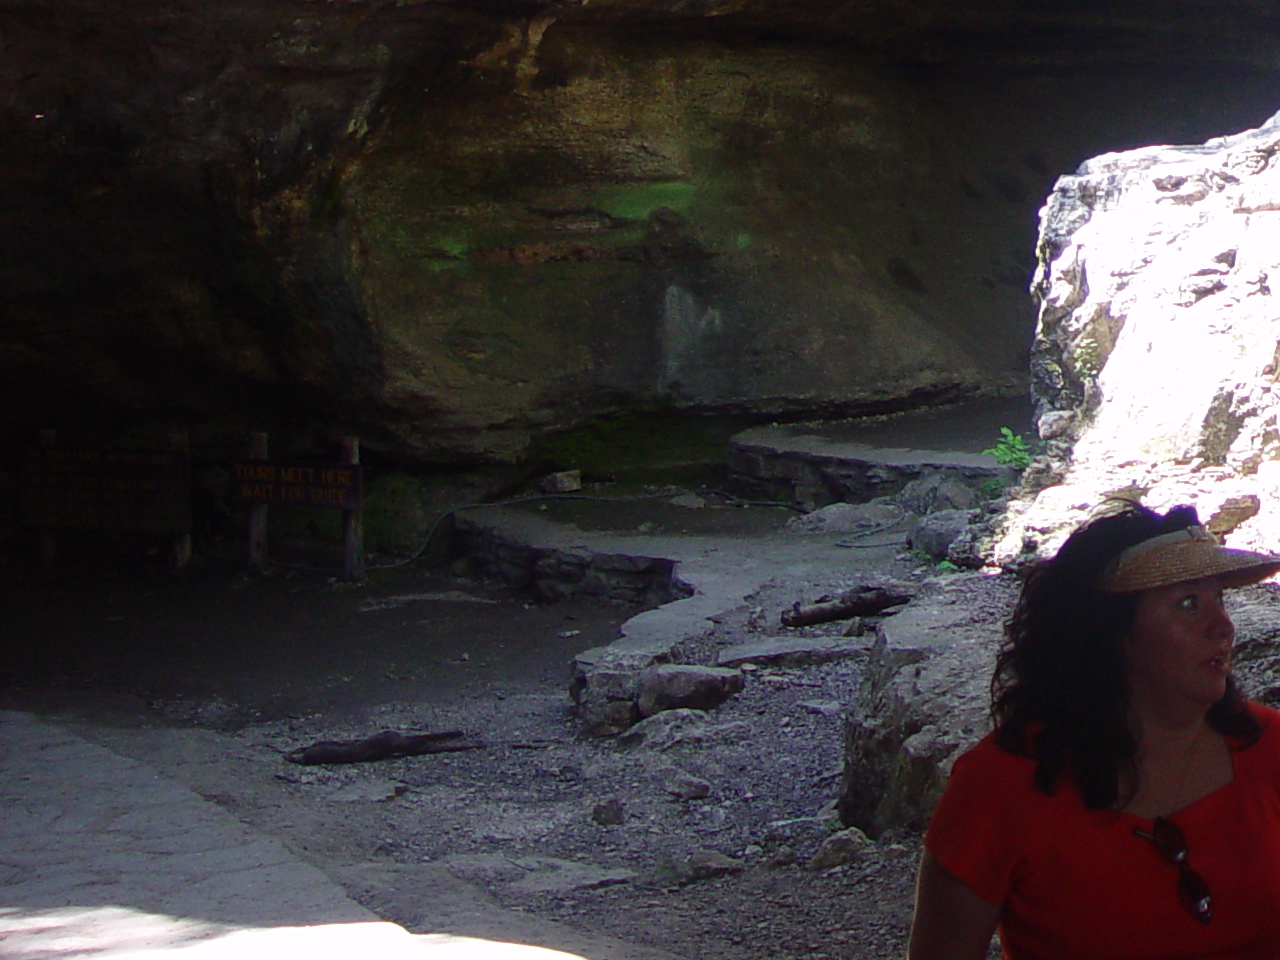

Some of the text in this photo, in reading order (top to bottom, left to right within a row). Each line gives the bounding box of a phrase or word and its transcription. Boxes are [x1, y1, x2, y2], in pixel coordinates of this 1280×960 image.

[235, 464, 353, 486] TOURS MEET HERE
[240, 483, 347, 503] WAIT FOR GUIDE
